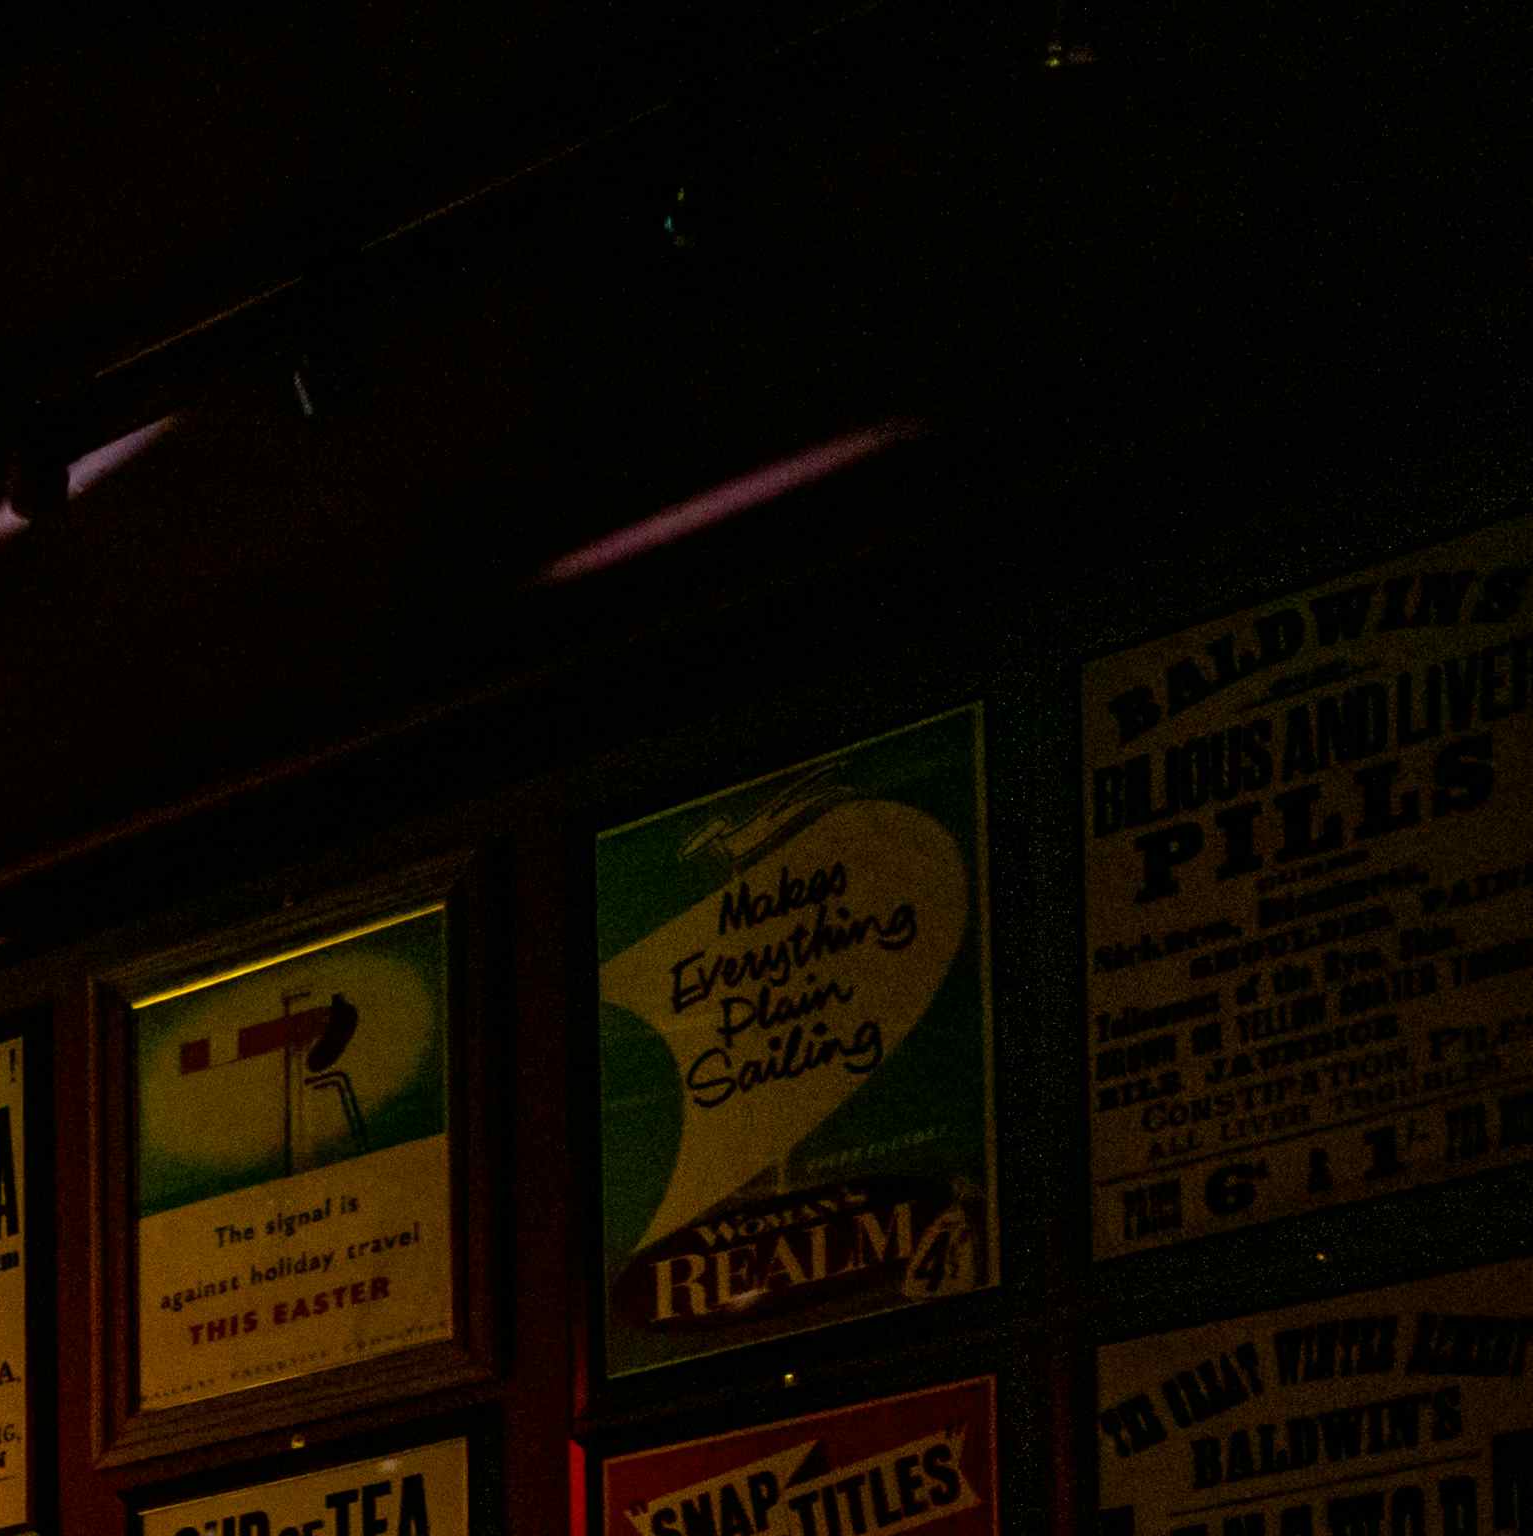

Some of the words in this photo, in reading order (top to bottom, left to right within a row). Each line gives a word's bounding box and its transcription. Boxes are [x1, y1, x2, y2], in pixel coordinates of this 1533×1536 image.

[1094, 717, 1273, 840] BILIOUS
[1282, 682, 1388, 783] AND
[1134, 731, 1495, 903] PILLS
[718, 862, 848, 936] Makes
[669, 901, 917, 1014] Everything
[718, 975, 855, 1047] Plain
[686, 1018, 885, 1109] Sailing
[1141, 1045, 1412, 1134] CONSTIPATION
[159, 1274, 241, 1314] against
[249, 1248, 335, 1289] holiday
[346, 1220, 422, 1260] travel
[213, 1220, 256, 1249] The
[264, 1197, 332, 1239] signal
[339, 1195, 359, 1216] is
[649, 1199, 918, 1323] REALM
[188, 1310, 260, 1347] THIS
[273, 1275, 391, 1327] EASTER
[1191, 1384, 1463, 1489] BALDWIN'S
